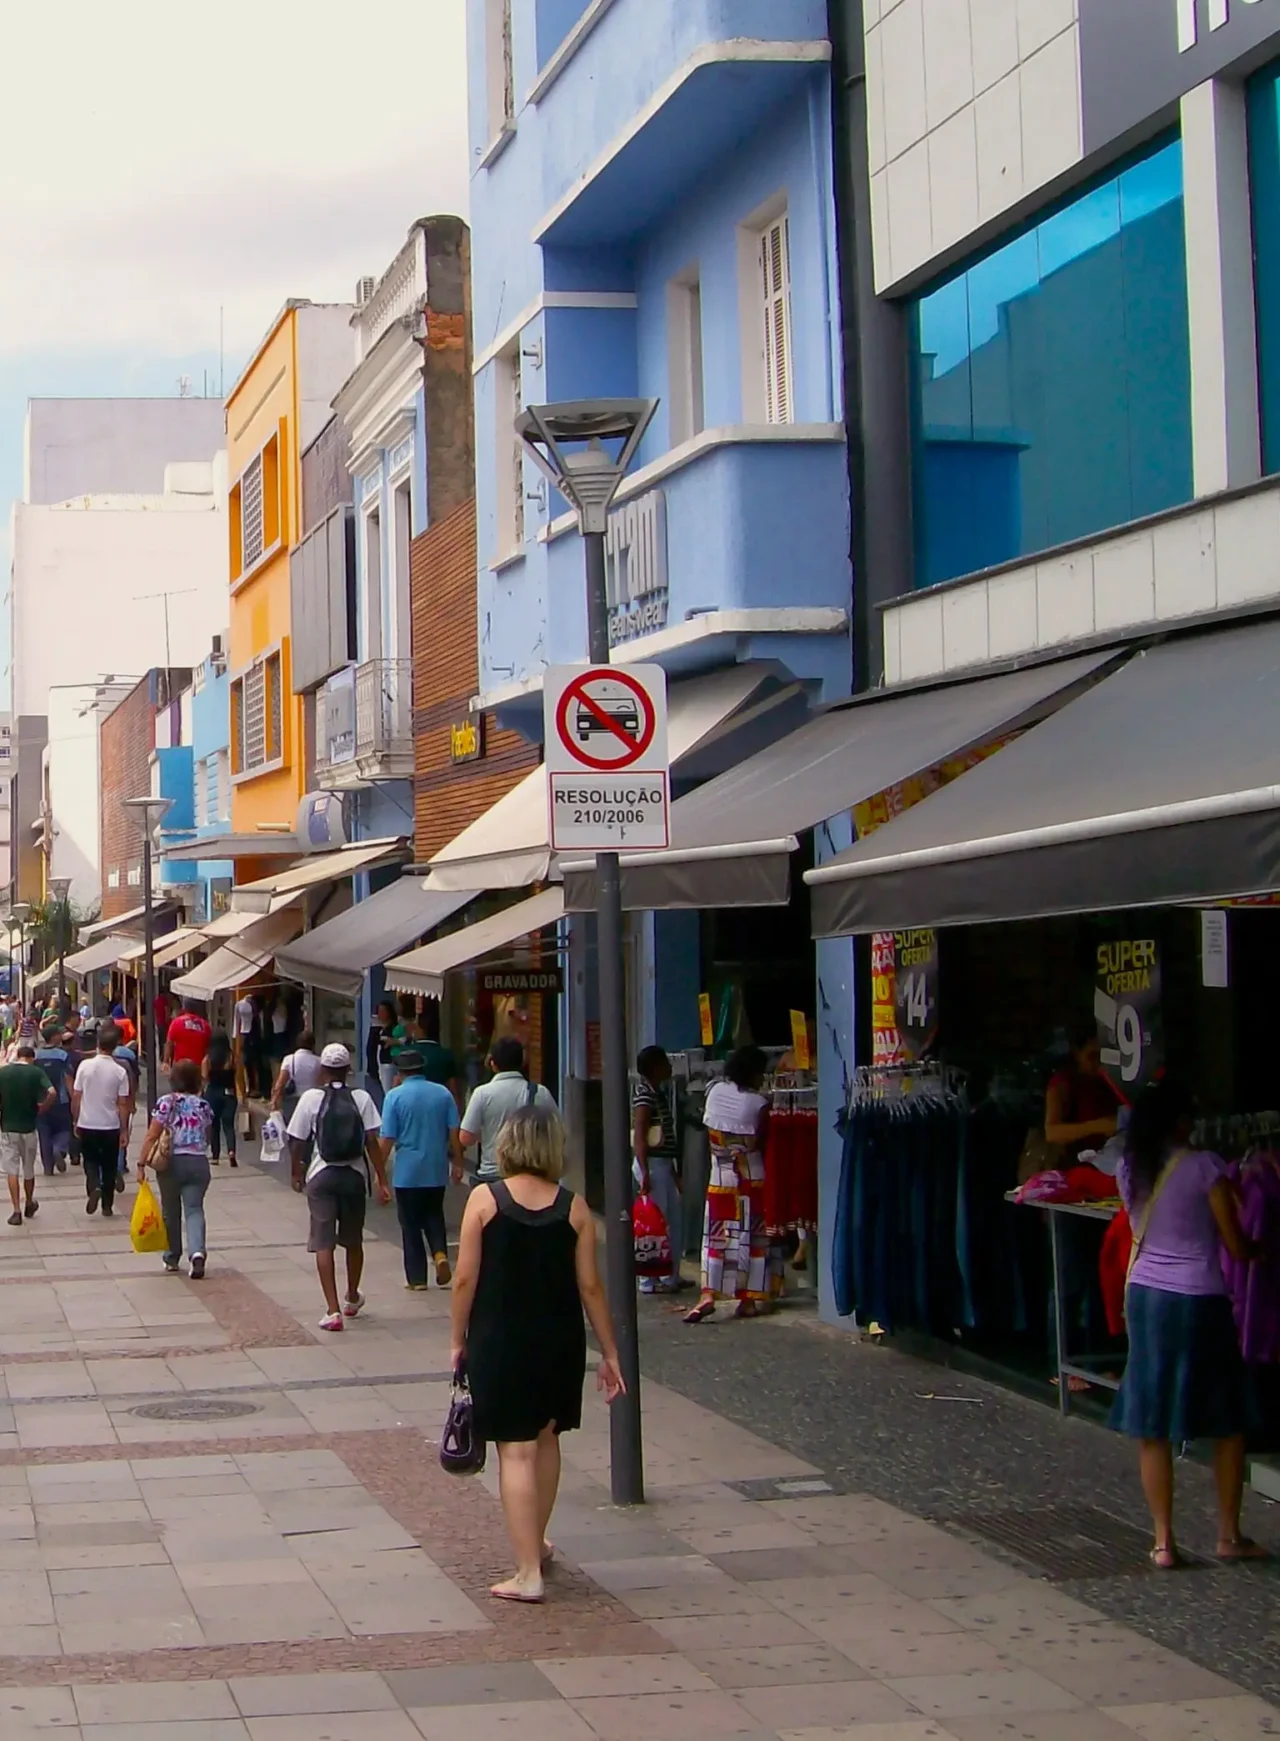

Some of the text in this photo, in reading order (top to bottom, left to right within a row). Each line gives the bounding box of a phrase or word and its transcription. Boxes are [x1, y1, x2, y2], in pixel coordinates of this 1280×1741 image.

[554, 788, 663, 808] RESOLUÇÃO
[573, 809, 644, 824] 210/2006
[1097, 939, 1156, 975] SUPER
[484, 974, 557, 990] GRAVADOR
[1106, 969, 1151, 996] OFERTA
[904, 972, 928, 1027] 14
[1117, 1004, 1142, 1082] 9
